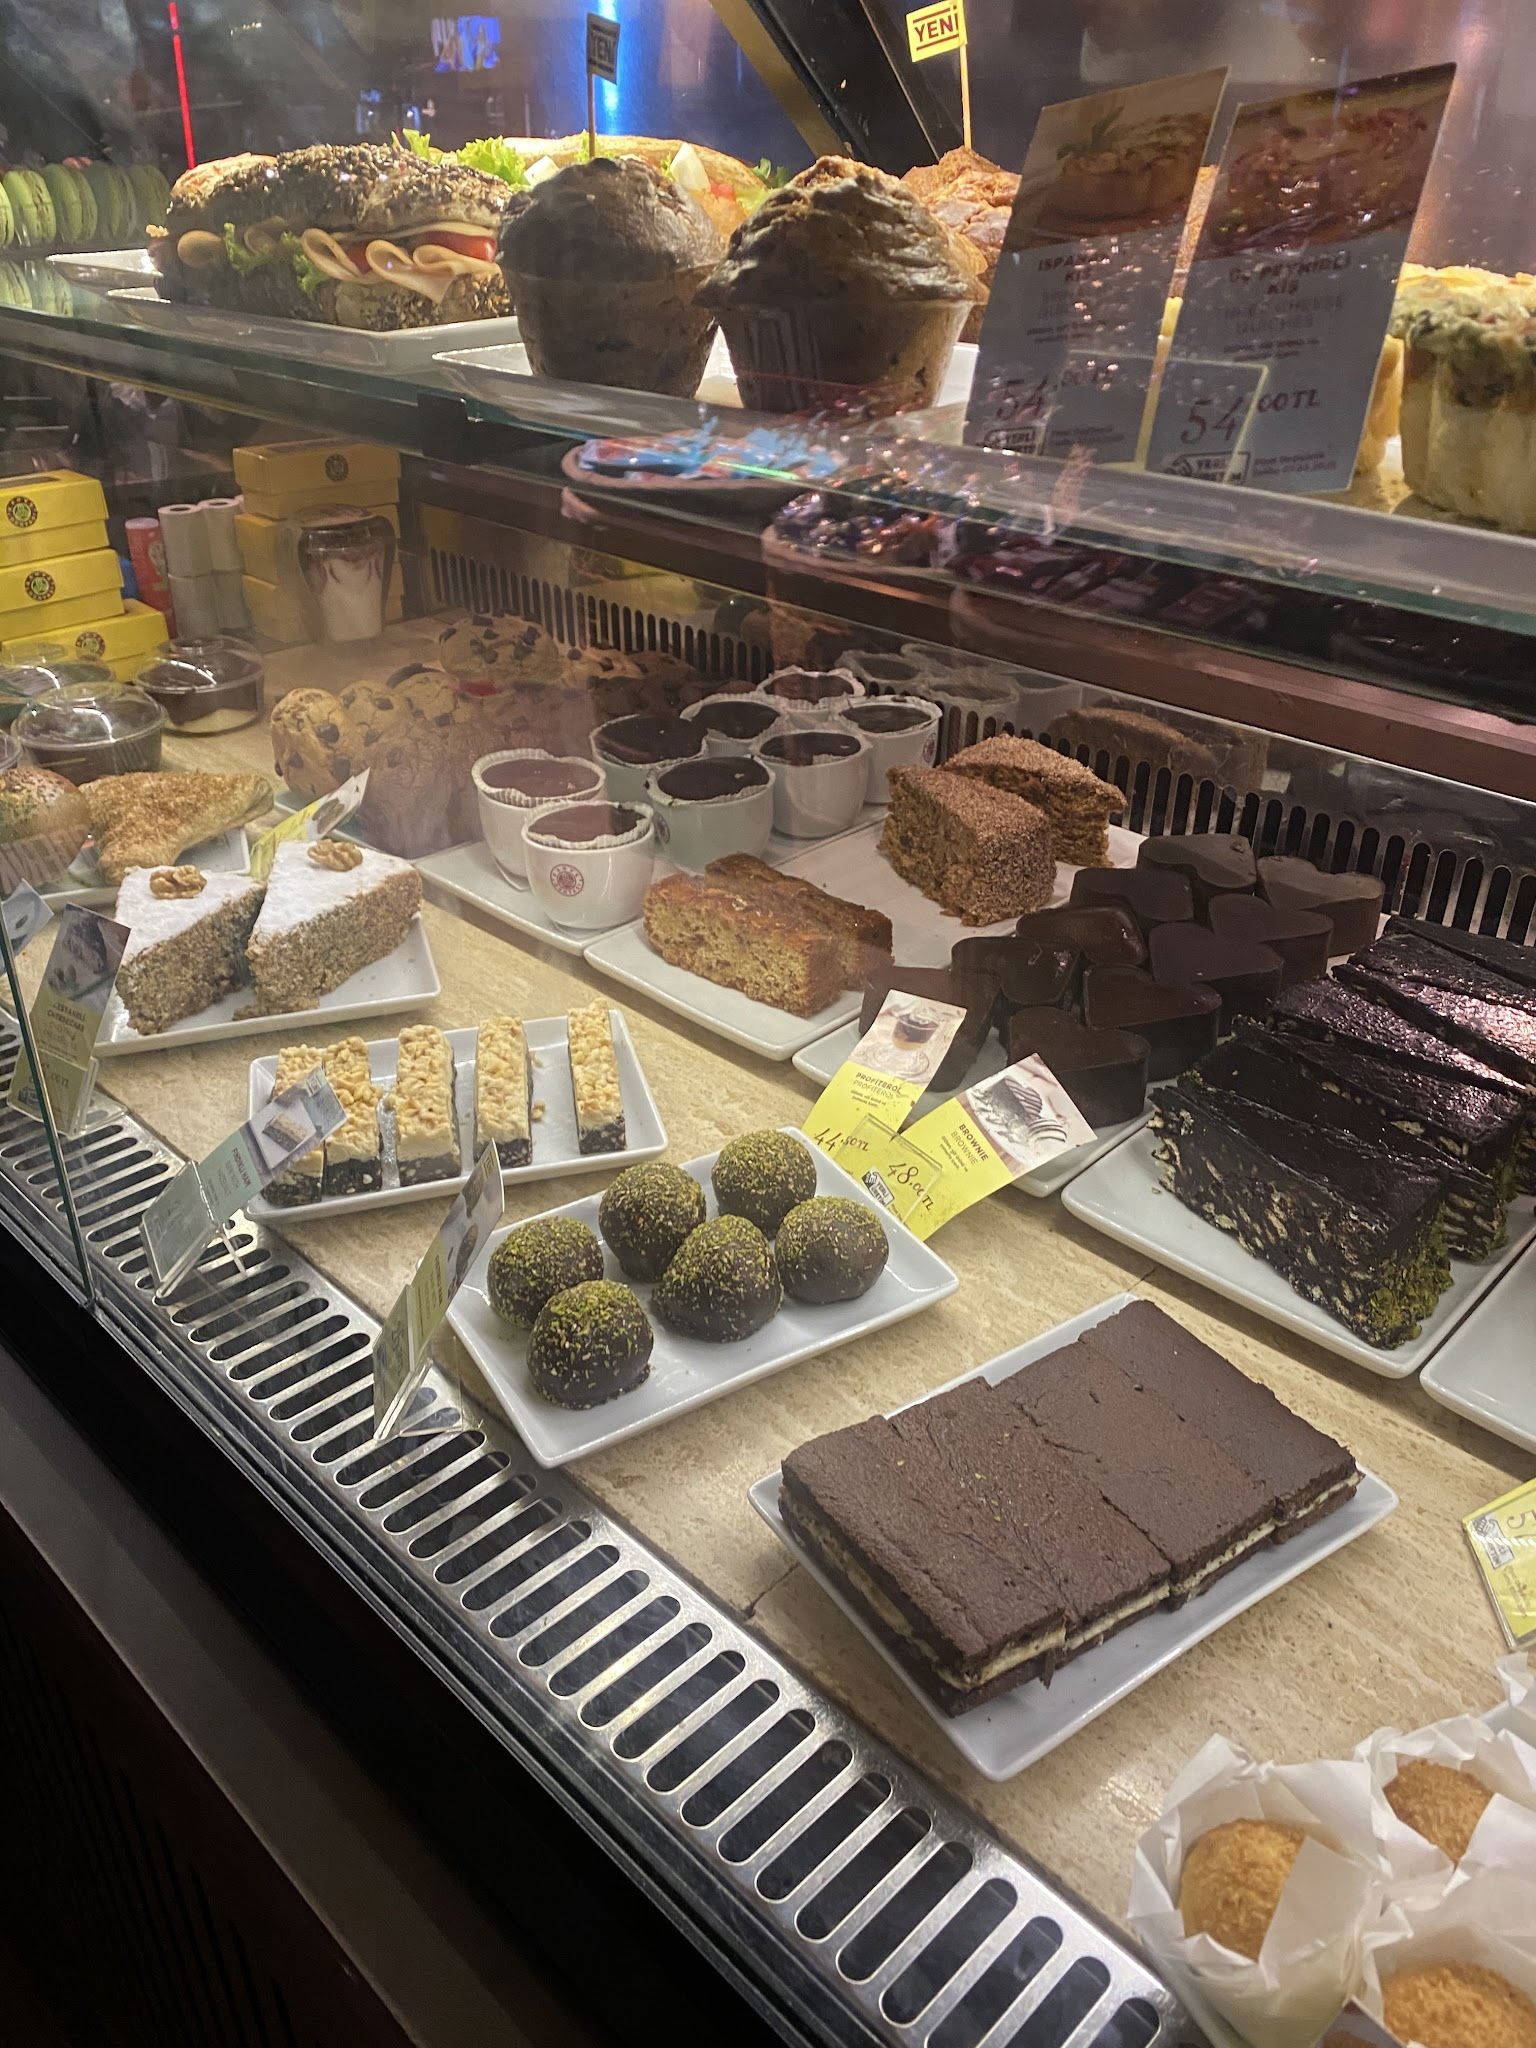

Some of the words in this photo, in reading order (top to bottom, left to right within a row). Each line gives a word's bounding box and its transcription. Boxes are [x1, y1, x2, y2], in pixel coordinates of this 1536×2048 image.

[914, 5, 959, 42] YENİ
[950, 1131, 978, 1164] BROWNIE
[958, 1123, 989, 1162] BROWNIE
